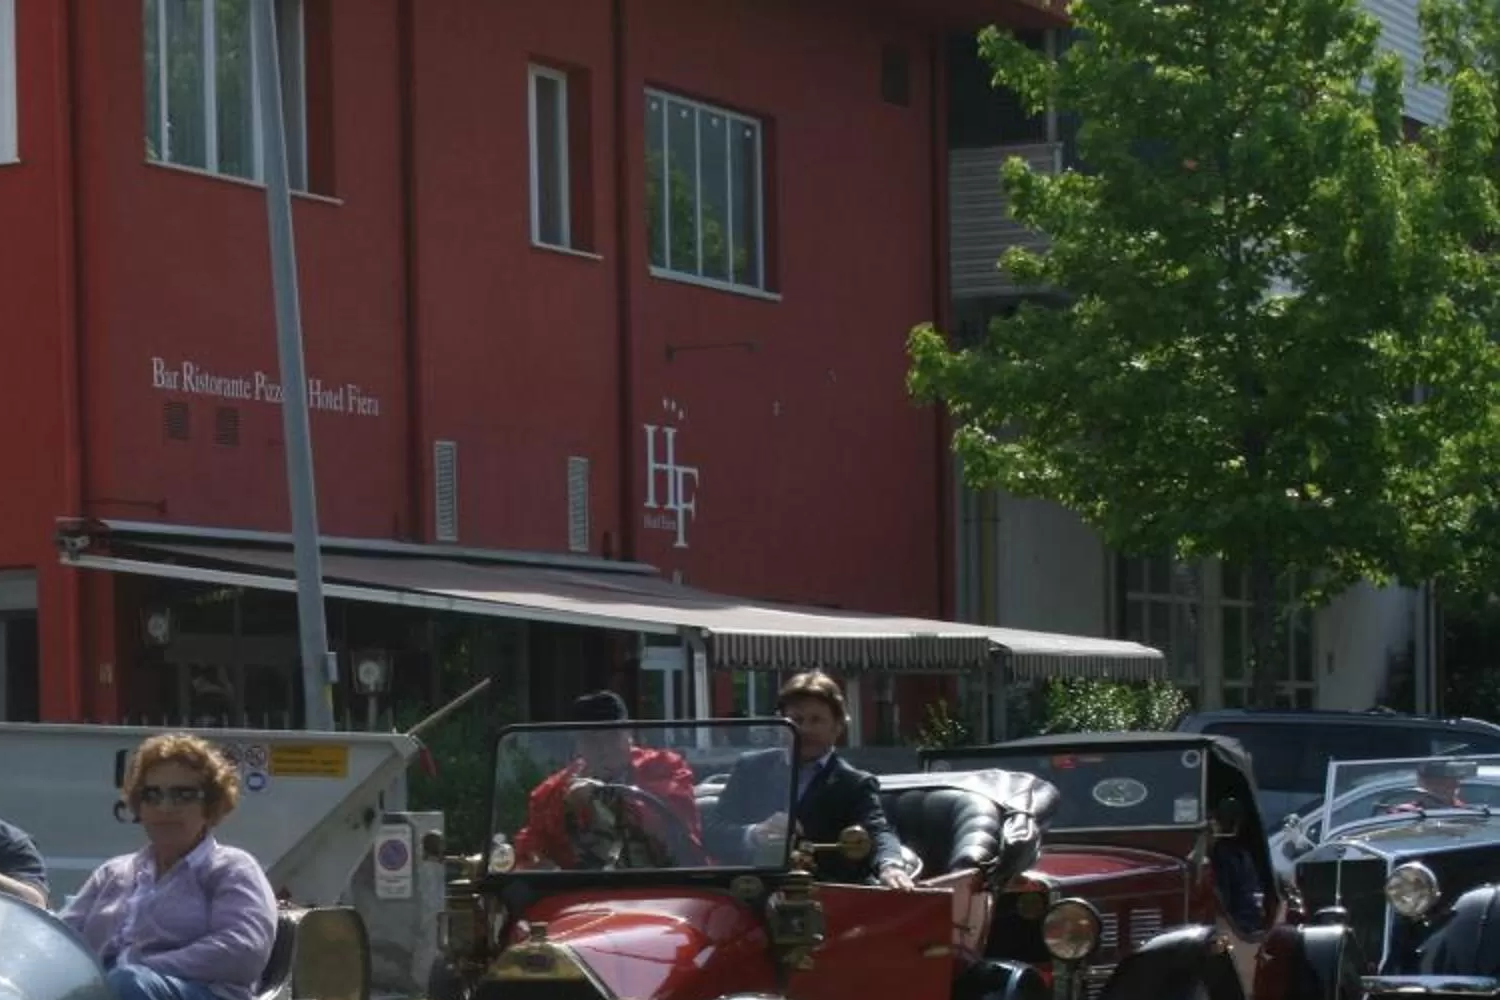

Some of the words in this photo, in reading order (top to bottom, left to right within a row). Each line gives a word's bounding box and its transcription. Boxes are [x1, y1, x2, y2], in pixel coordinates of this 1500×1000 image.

[151, 356, 179, 390] Bar
[182, 360, 252, 399] Ristorante
[308, 379, 344, 412] Hotel
[346, 384, 379, 416] Fiera
